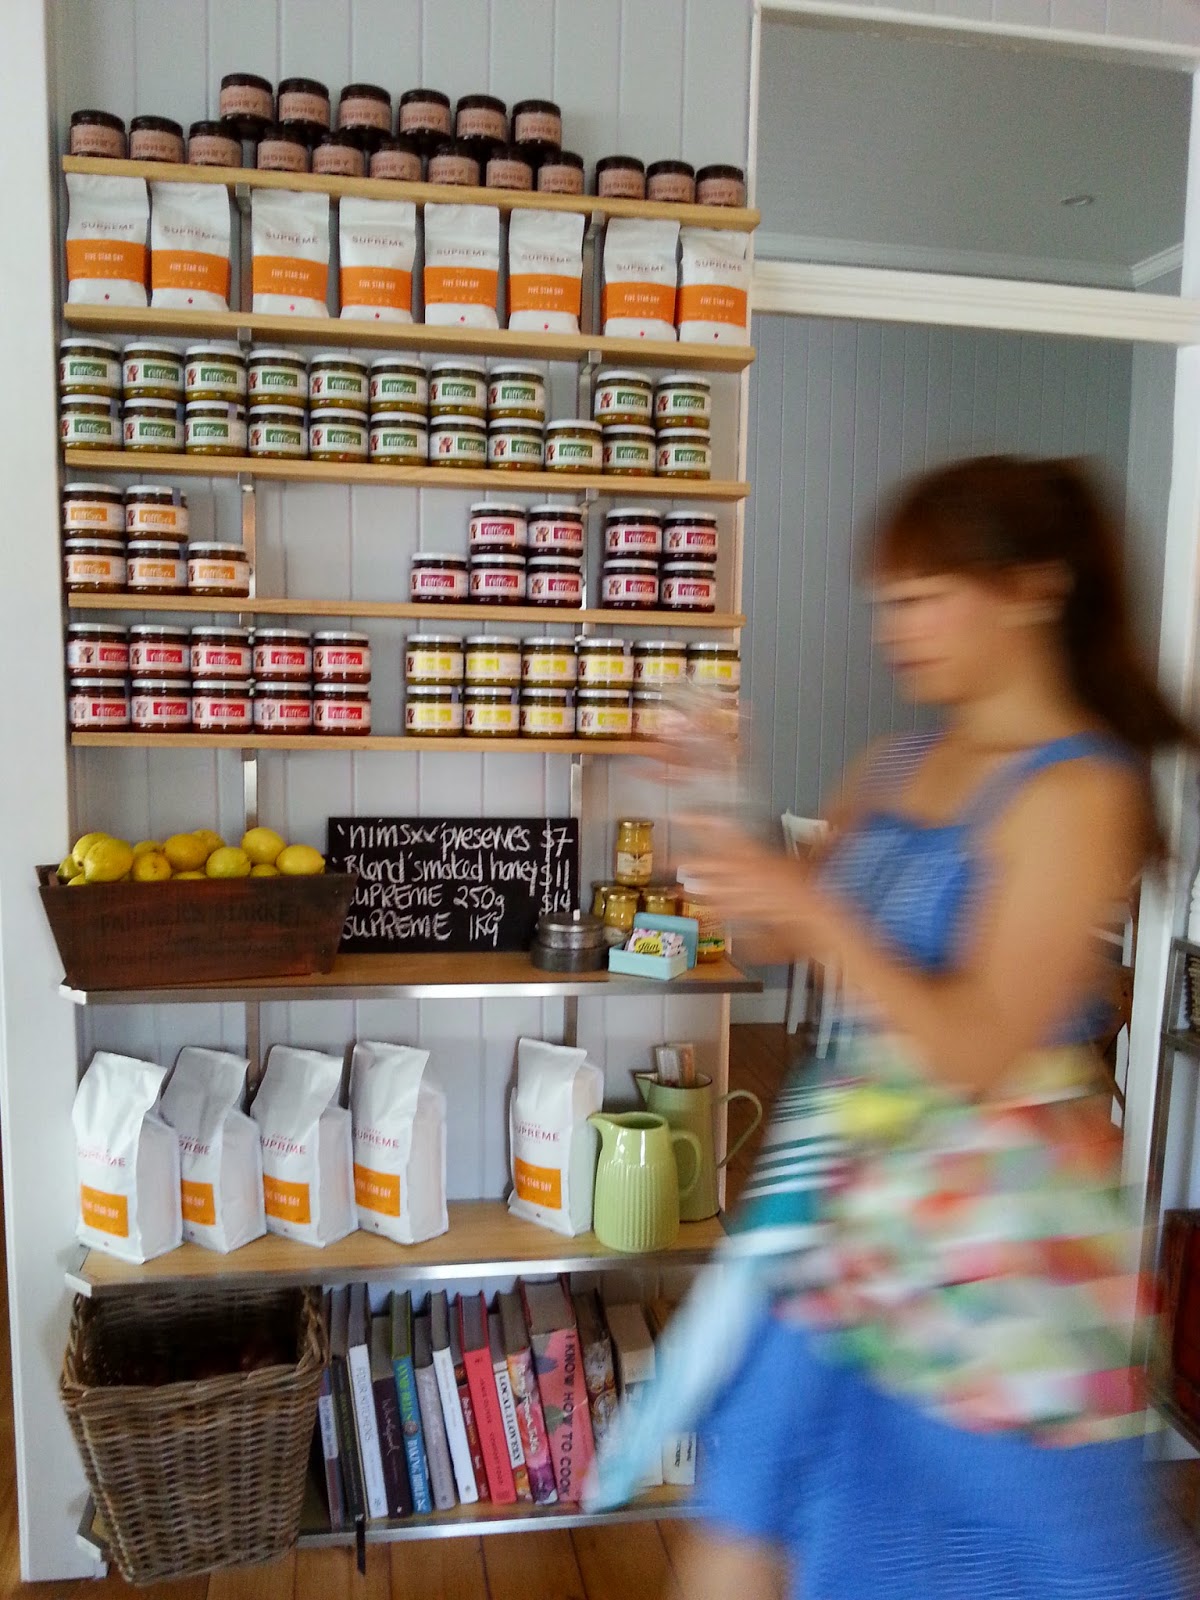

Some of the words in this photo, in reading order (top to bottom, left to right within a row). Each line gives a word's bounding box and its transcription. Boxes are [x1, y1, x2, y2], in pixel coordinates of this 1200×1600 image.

[81, 222, 134, 230] SUPREME
[163, 226, 217, 240] SUPREME
[265, 232, 318, 244] SUPREME
[353, 236, 404, 247] SUPREME
[522, 255, 571, 263] SUPREME
[617, 264, 664, 272] SUPREME
[695, 260, 742, 272] SUPREME
[441, 825, 531, 860] preserves
[540, 823, 574, 860] $7
[413, 851, 483, 882] smoked
[490, 851, 537, 896] honey
[540, 859, 570, 889] $11
[350, 884, 443, 909] UPREME
[454, 886, 505, 918] 250g
[342, 911, 451, 940] SUPREME
[563, 1344, 576, 1386] KNOW
[562, 1392, 575, 1425] HOW
[561, 1431, 573, 1451] TO
[558, 1457, 572, 1496] COOK
